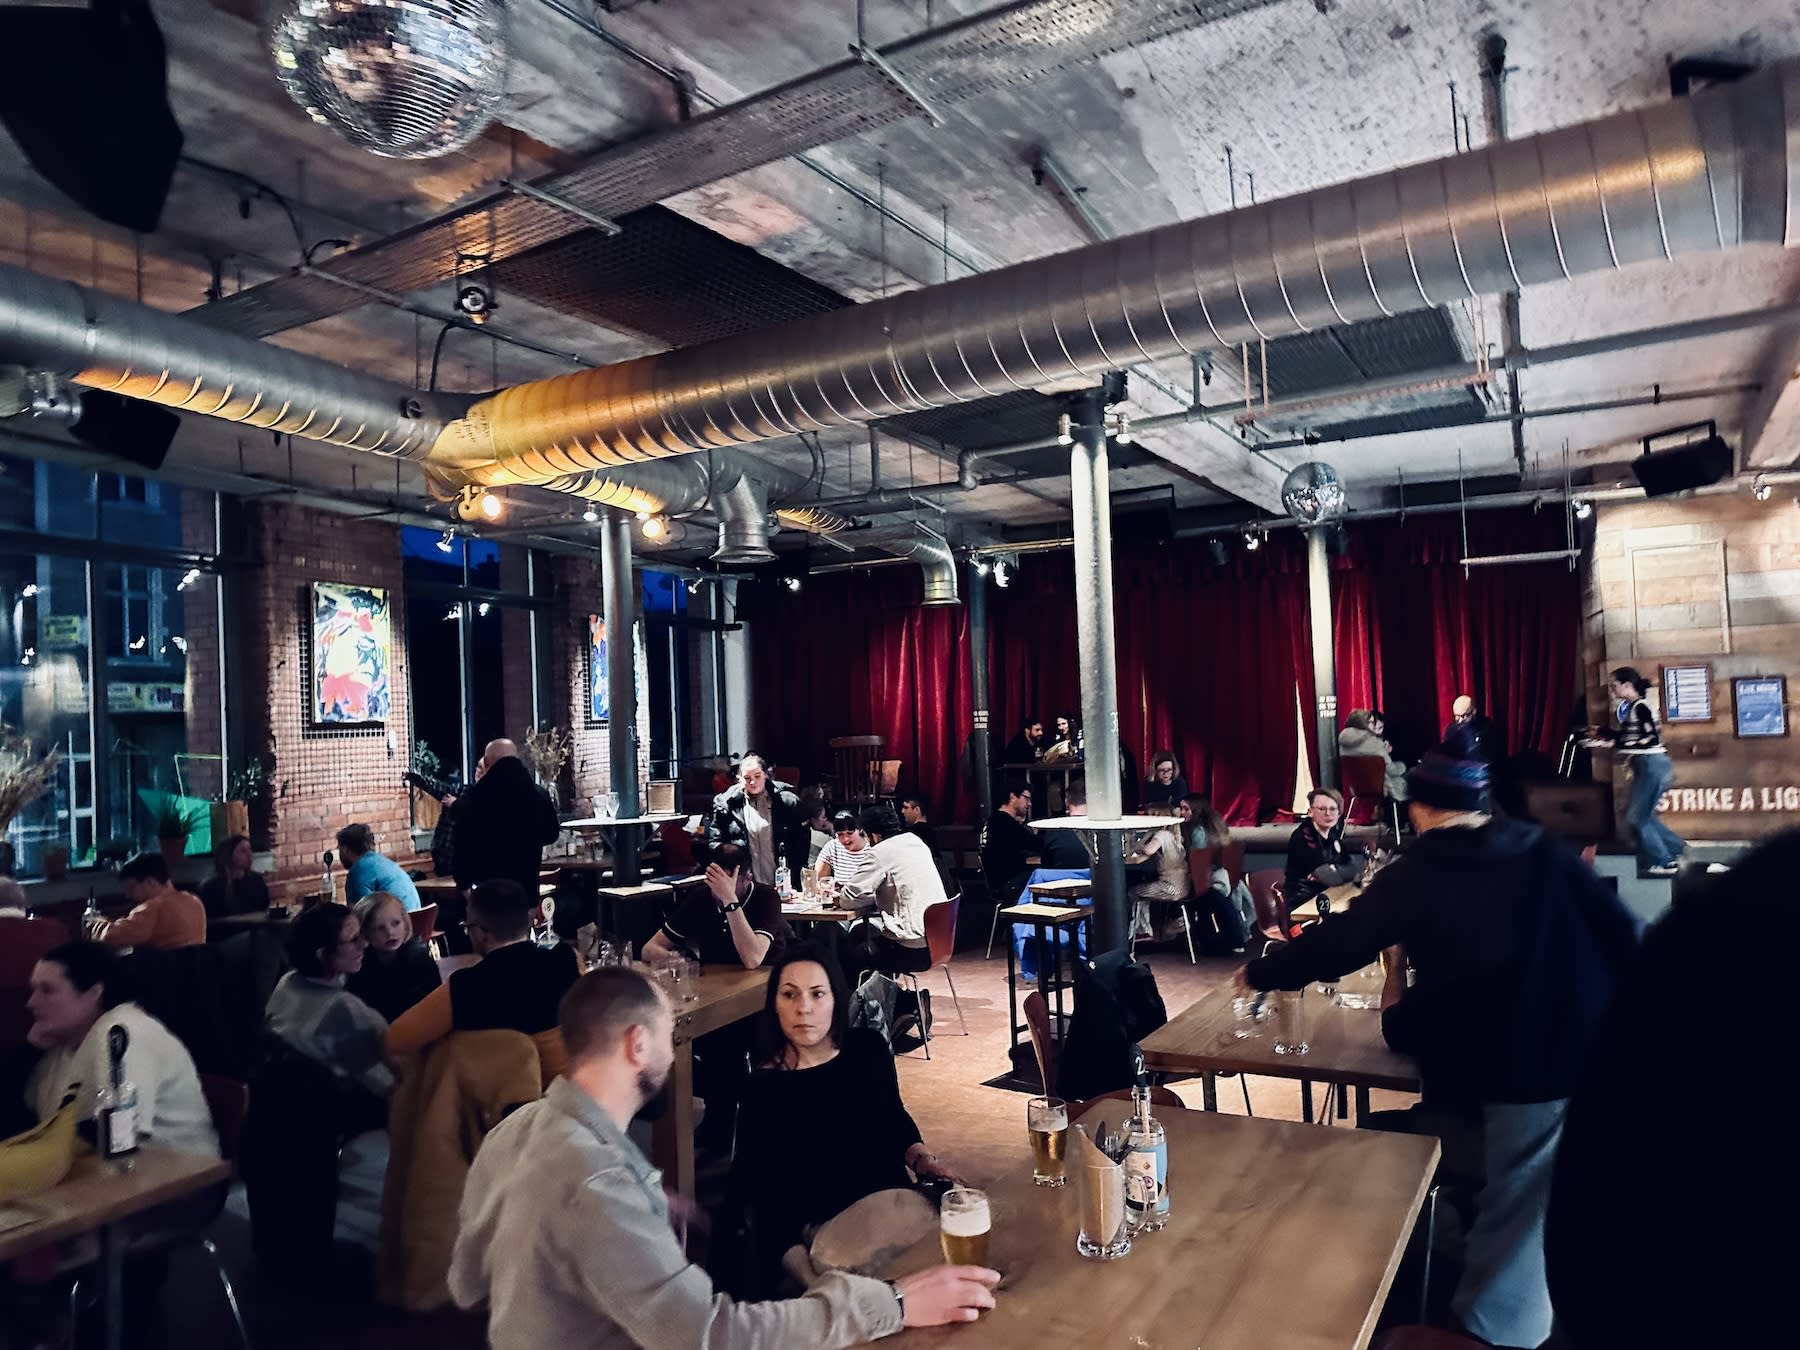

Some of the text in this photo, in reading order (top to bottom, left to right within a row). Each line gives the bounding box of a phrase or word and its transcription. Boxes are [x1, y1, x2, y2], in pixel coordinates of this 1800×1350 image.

[1655, 786, 1800, 812] STRIKE A LIG
